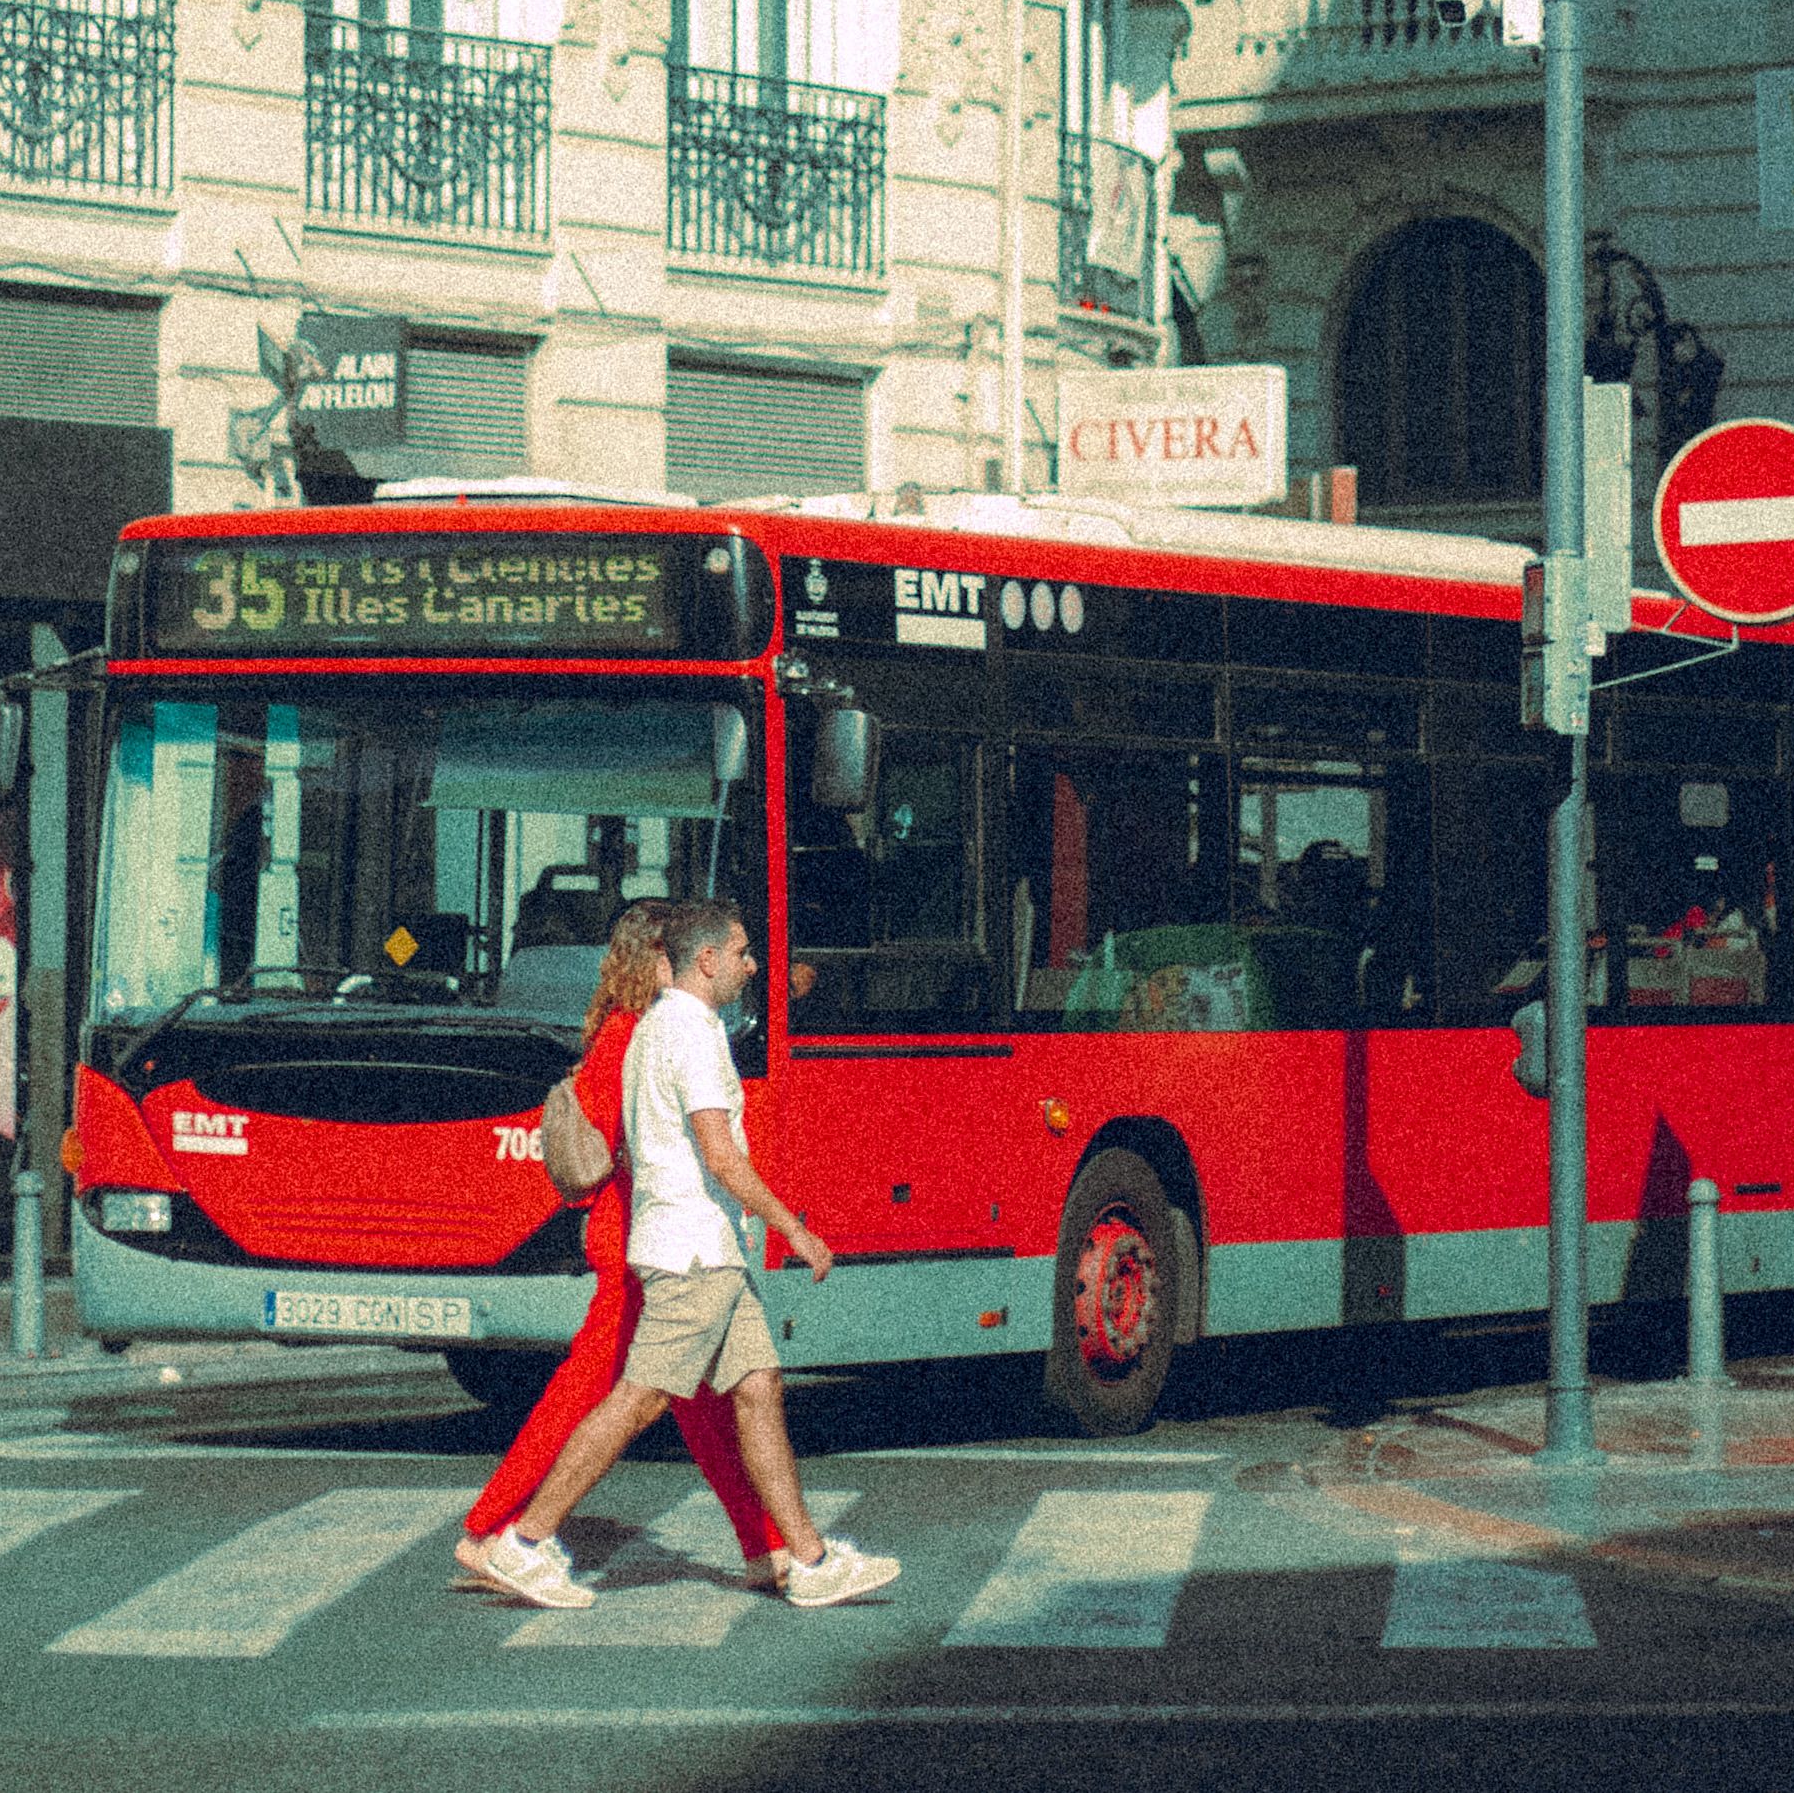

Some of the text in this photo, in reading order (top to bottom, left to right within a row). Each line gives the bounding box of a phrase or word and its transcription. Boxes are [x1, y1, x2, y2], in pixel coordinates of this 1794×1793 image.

[334, 352, 396, 380] ALAIN
[1069, 417, 1259, 462] CIVERA
[295, 552, 404, 584] Arts
[193, 551, 286, 630] 35
[303, 587, 648, 625] Illes Canaries
[894, 568, 985, 615] EMT
[173, 1112, 248, 1136] EMT
[280, 1296, 341, 1325] 3029
[416, 1301, 462, 1332] SP
